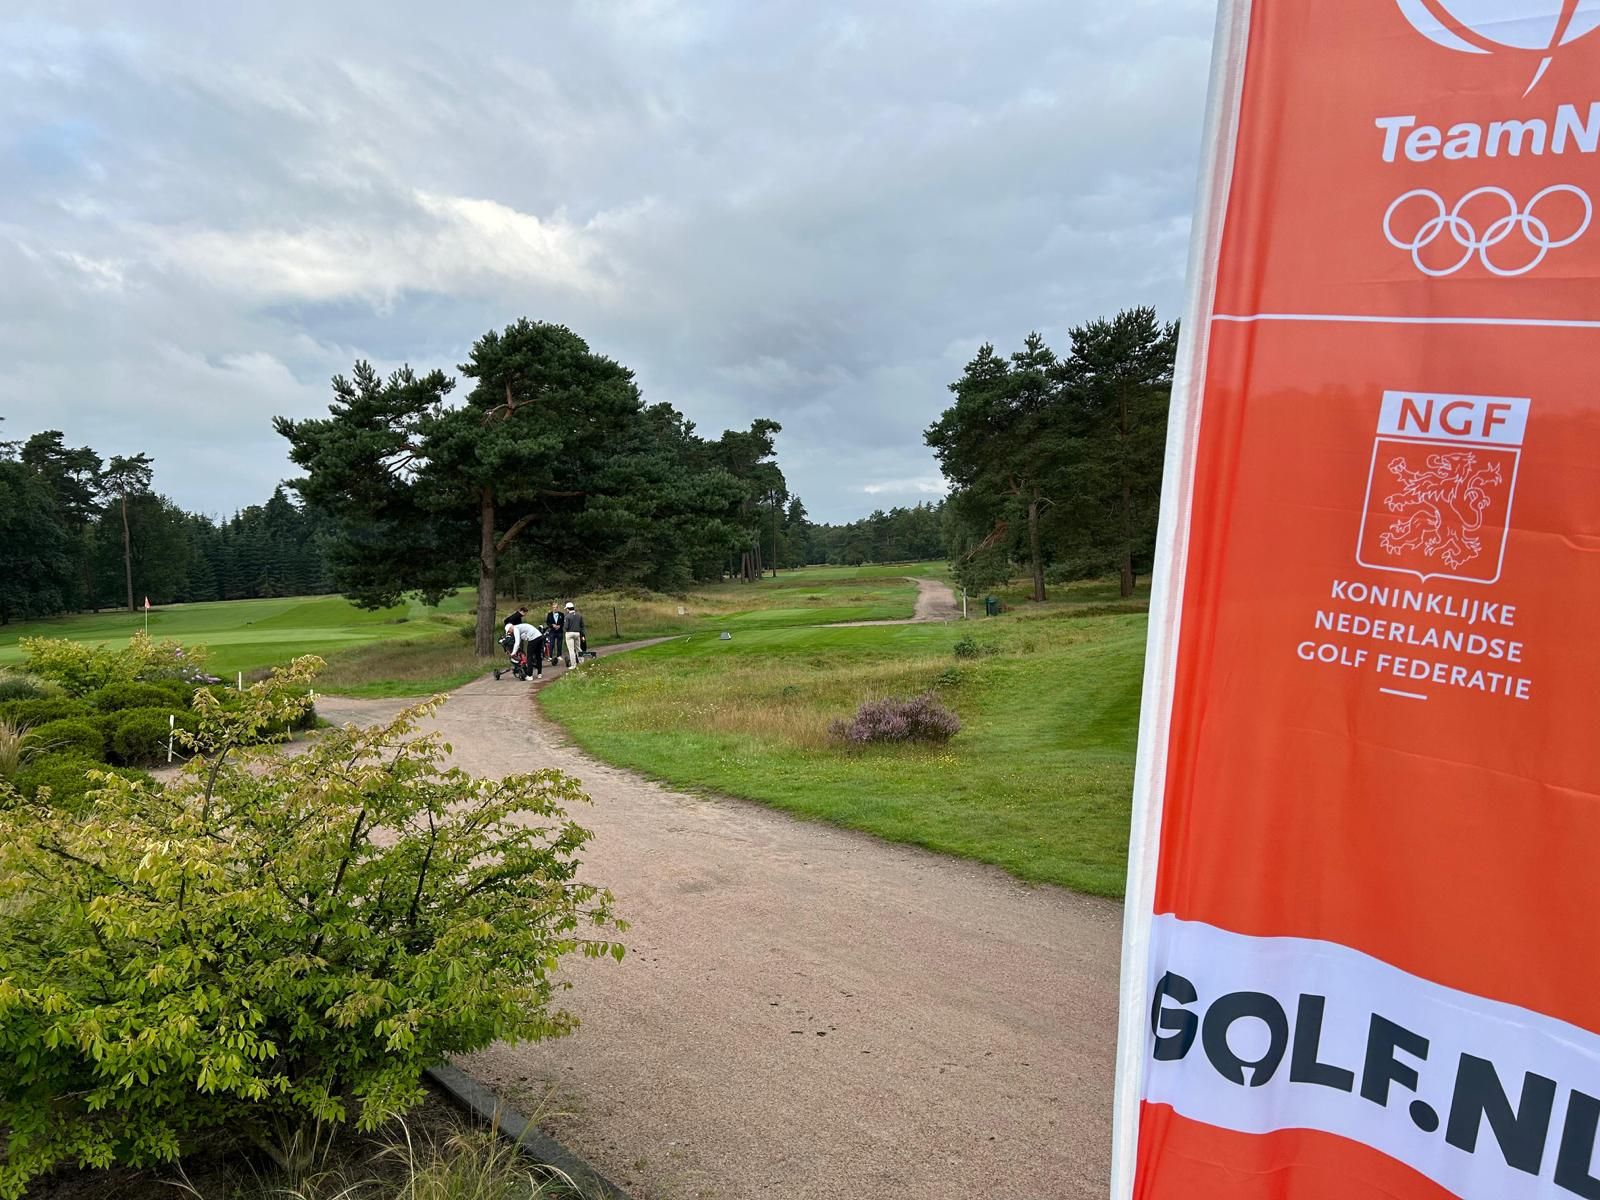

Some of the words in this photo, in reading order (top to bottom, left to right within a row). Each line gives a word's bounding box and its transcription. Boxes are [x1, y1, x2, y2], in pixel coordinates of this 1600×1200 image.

[1397, 398, 1512, 437] NGF
[1331, 580, 1516, 626] KONINKLIJKE
[1314, 610, 1523, 663] NEDERLANDSE
[1297, 641, 1368, 668] GOLF
[1376, 654, 1532, 700] FEDERATIE
[1151, 970, 1600, 1200] GOLF.NL
